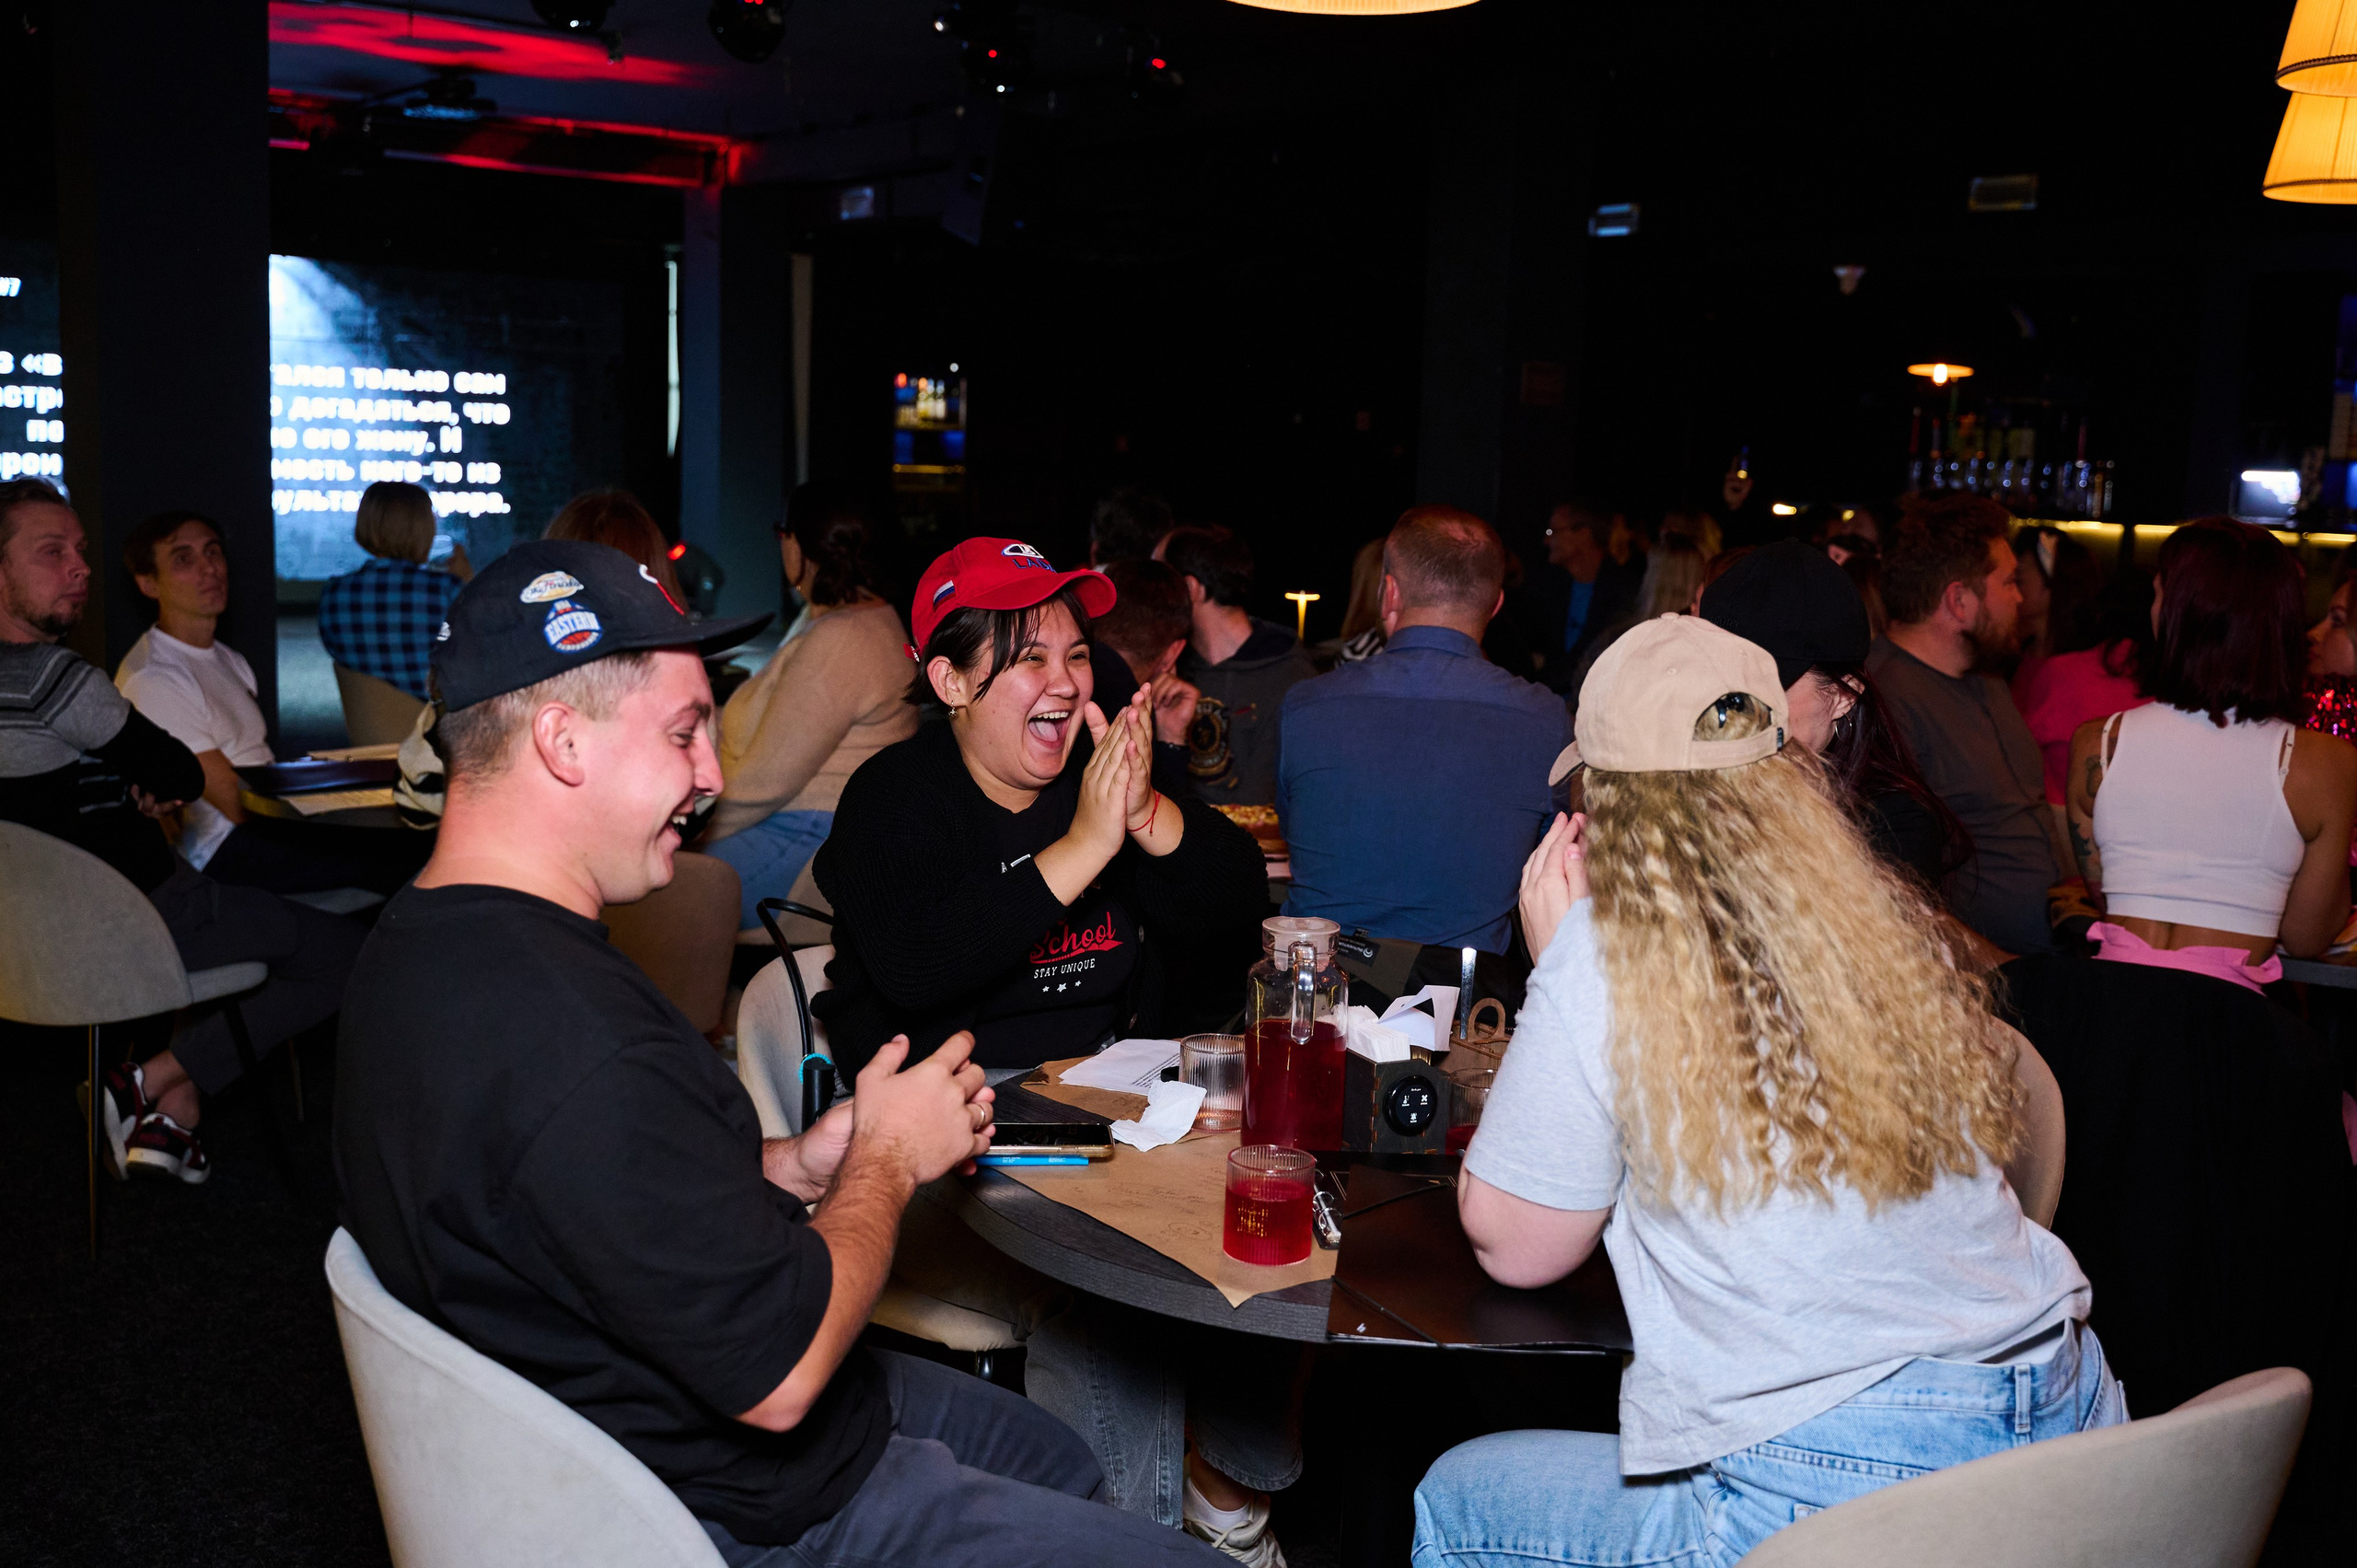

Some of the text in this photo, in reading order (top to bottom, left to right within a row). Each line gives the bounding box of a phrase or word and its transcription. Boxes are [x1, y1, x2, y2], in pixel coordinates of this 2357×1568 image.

[270, 365, 345, 388] ался
[351, 367, 449, 392] только
[288, 397, 459, 425] догадаться,
[463, 402, 511, 425] что
[440, 425, 462, 453] И
[1033, 958, 1096, 980] STAY UNIQUE
